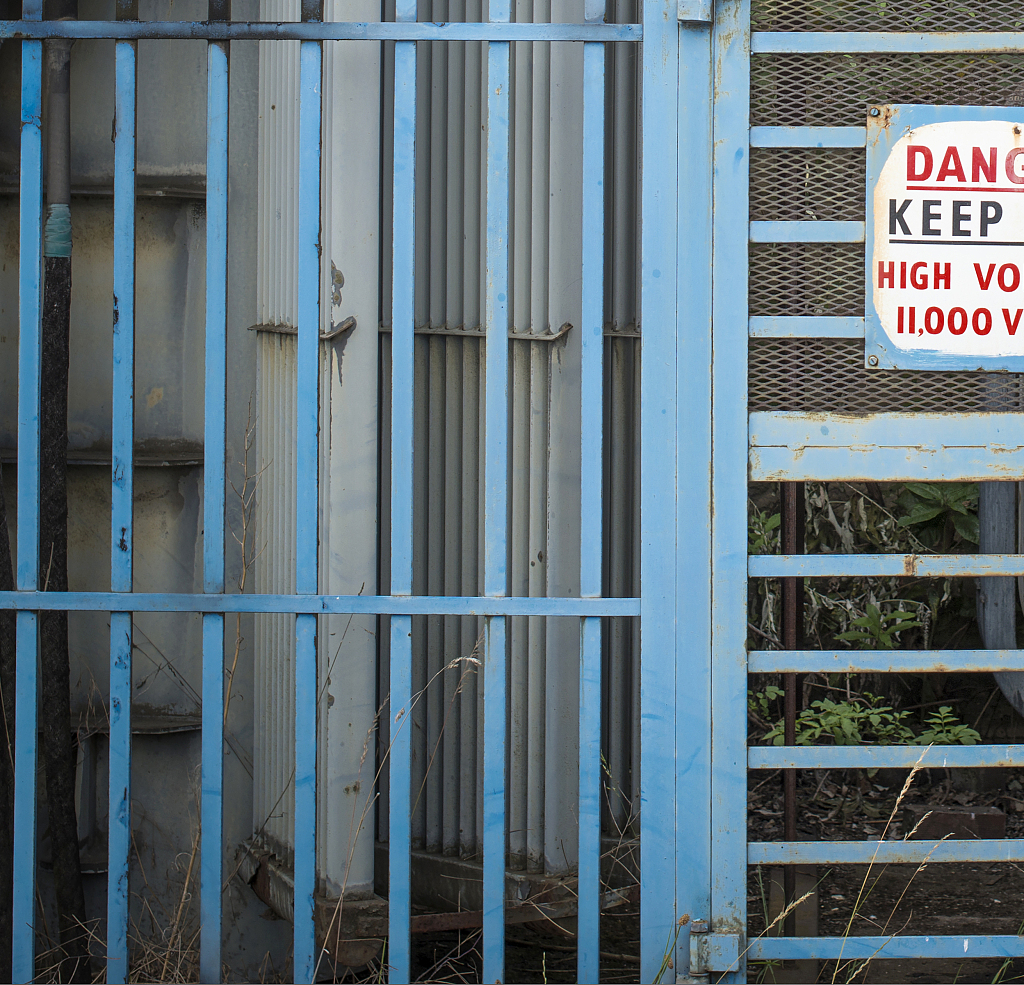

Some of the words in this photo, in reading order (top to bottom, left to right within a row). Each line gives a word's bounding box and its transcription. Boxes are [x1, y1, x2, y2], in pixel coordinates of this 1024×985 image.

[889, 199, 1003, 237] KEEP
[877, 260, 952, 290] HIGH
[897, 306, 993, 337] 11,000
